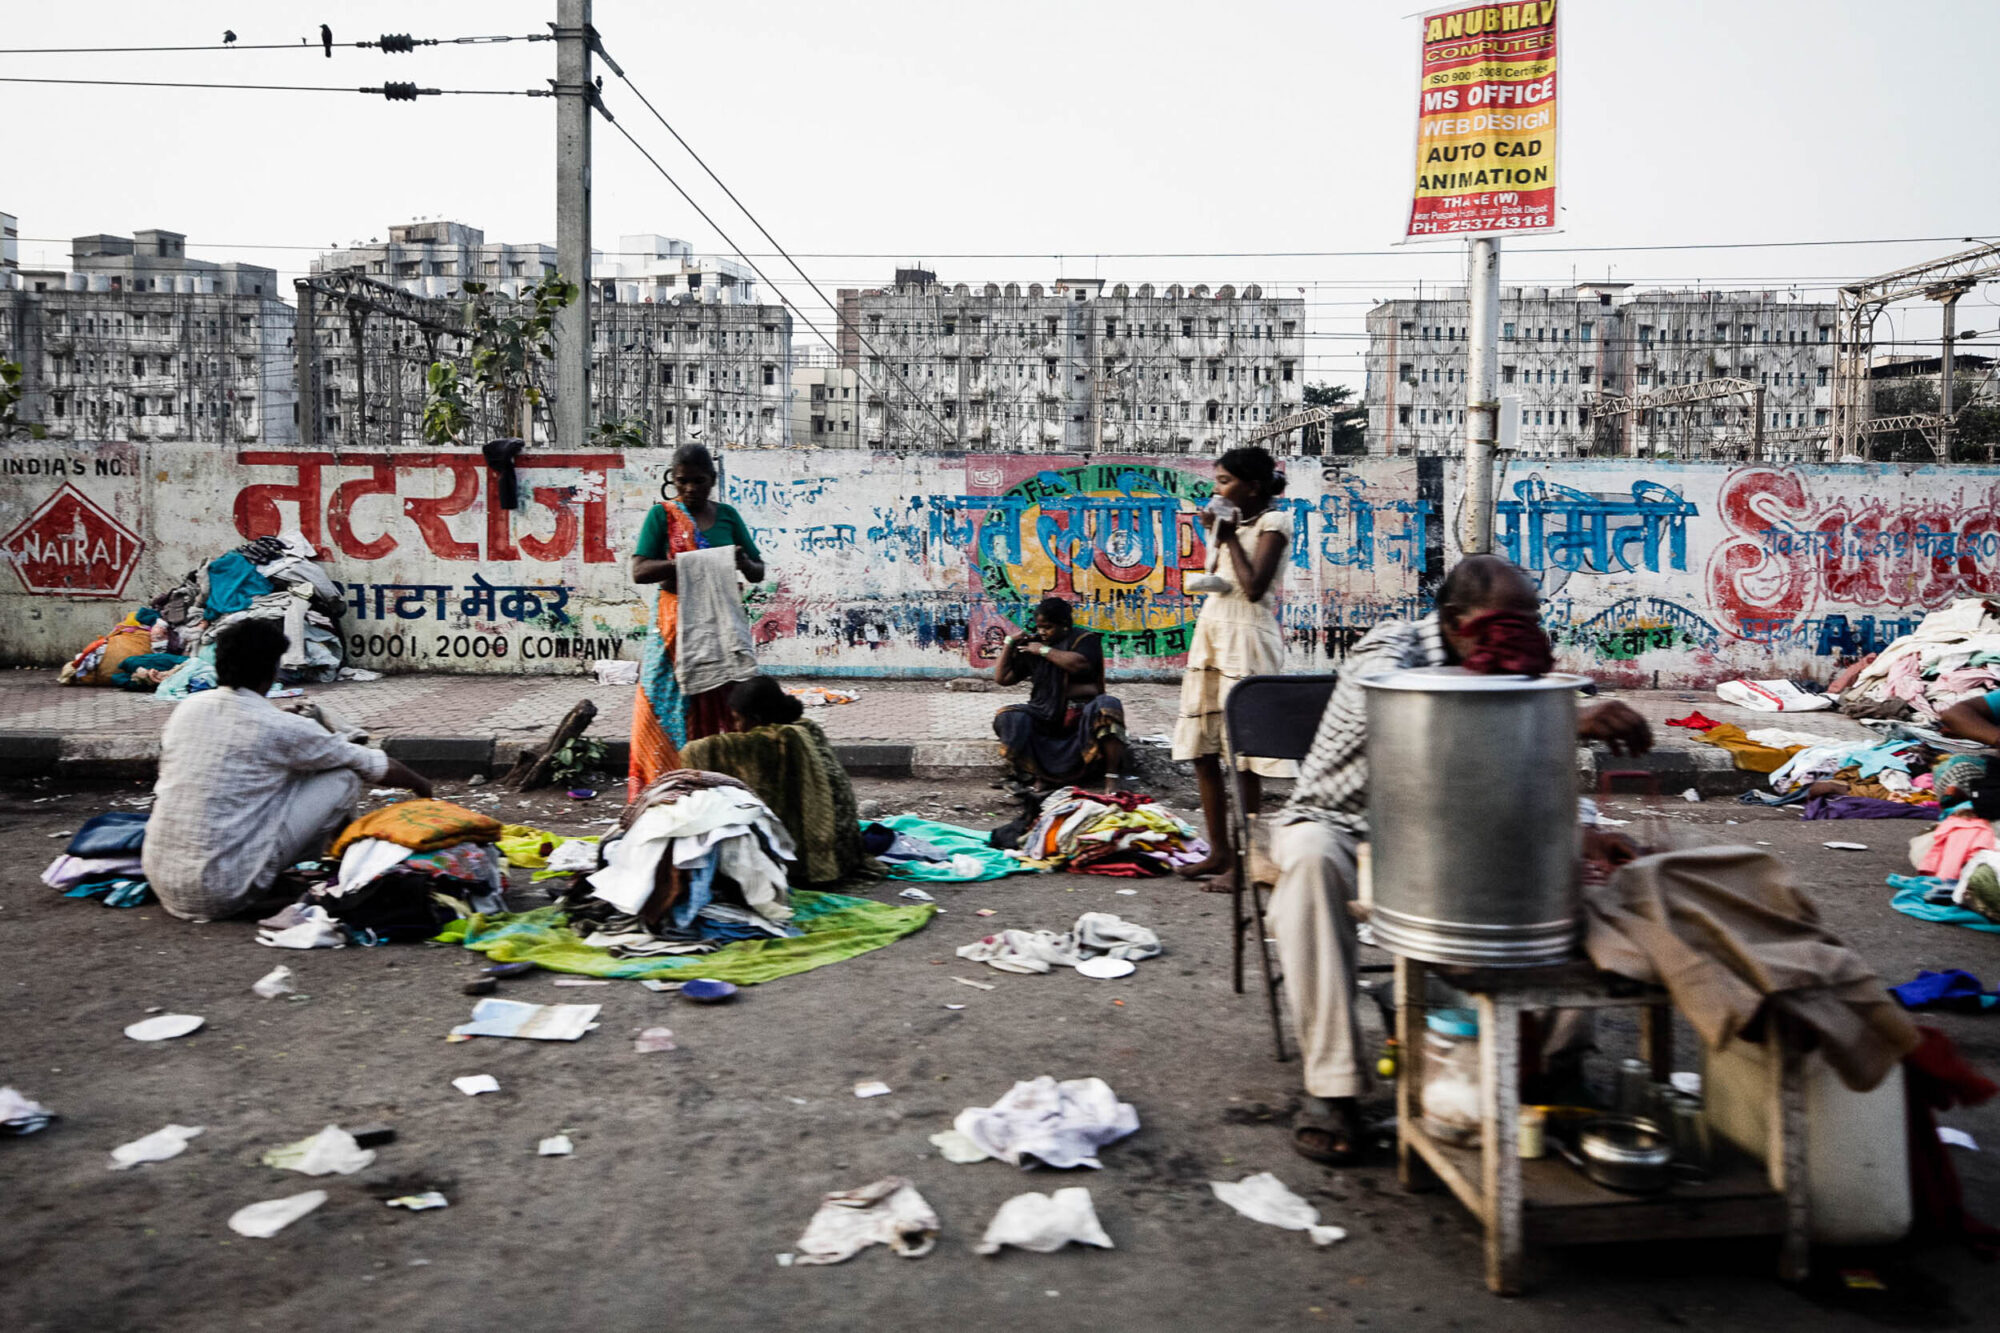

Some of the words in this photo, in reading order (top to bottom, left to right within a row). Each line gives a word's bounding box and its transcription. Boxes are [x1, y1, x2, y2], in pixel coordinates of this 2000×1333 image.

[1424, 91, 1459, 112] MS
[1468, 77, 1553, 105] OFFICE
[1427, 142, 1486, 163] AUTO
[1494, 140, 1542, 157] CAD
[1419, 165, 1547, 190] ANIMATION
[1493, 192, 1519, 206] (W)
[3, 458, 86, 476] INDIA'S
[232, 451, 624, 563] नटराज
[460, 572, 575, 624] मेकर
[436, 635, 508, 658] 2000
[522, 636, 623, 660] COMPANY
